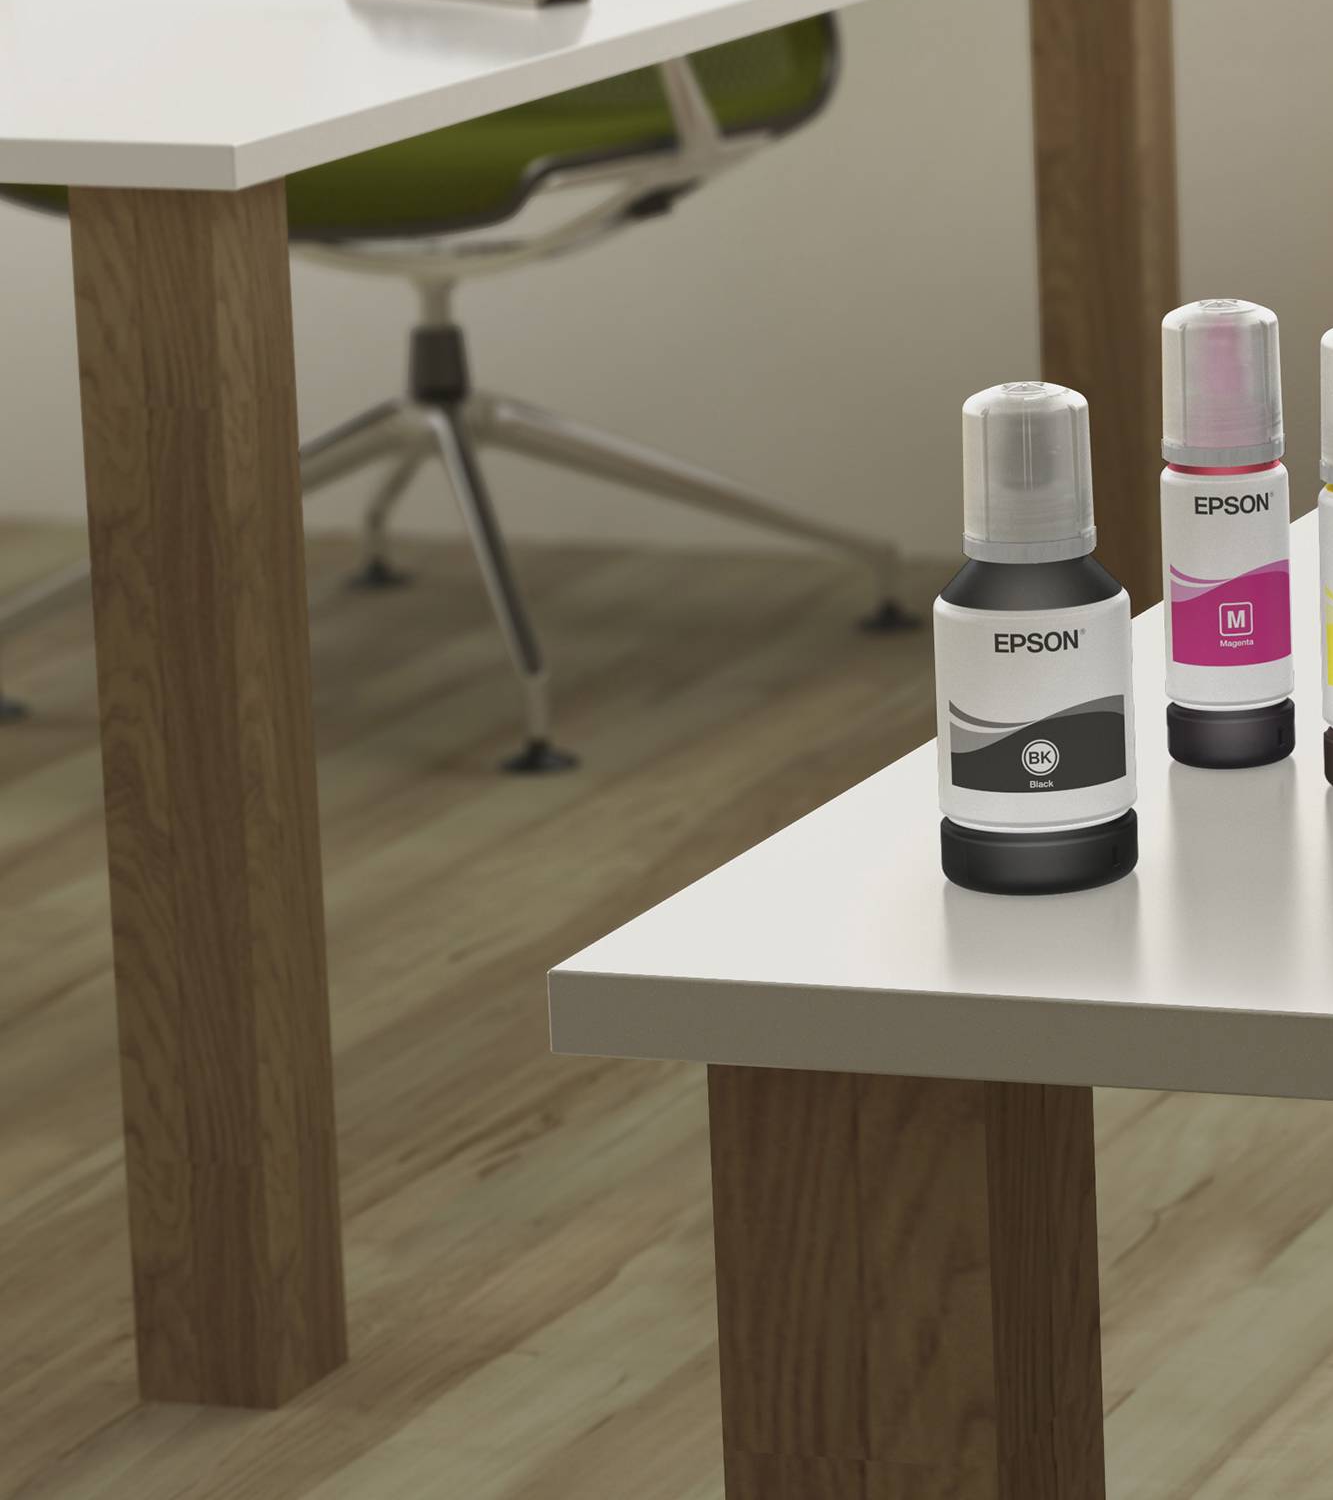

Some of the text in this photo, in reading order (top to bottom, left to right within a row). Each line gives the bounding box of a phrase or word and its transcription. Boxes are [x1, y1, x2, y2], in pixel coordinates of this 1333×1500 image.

[1227, 610, 1246, 629] M
[1220, 638, 1254, 648] Magenta
[1028, 750, 1053, 765] BK
[1029, 780, 1054, 789] Black
